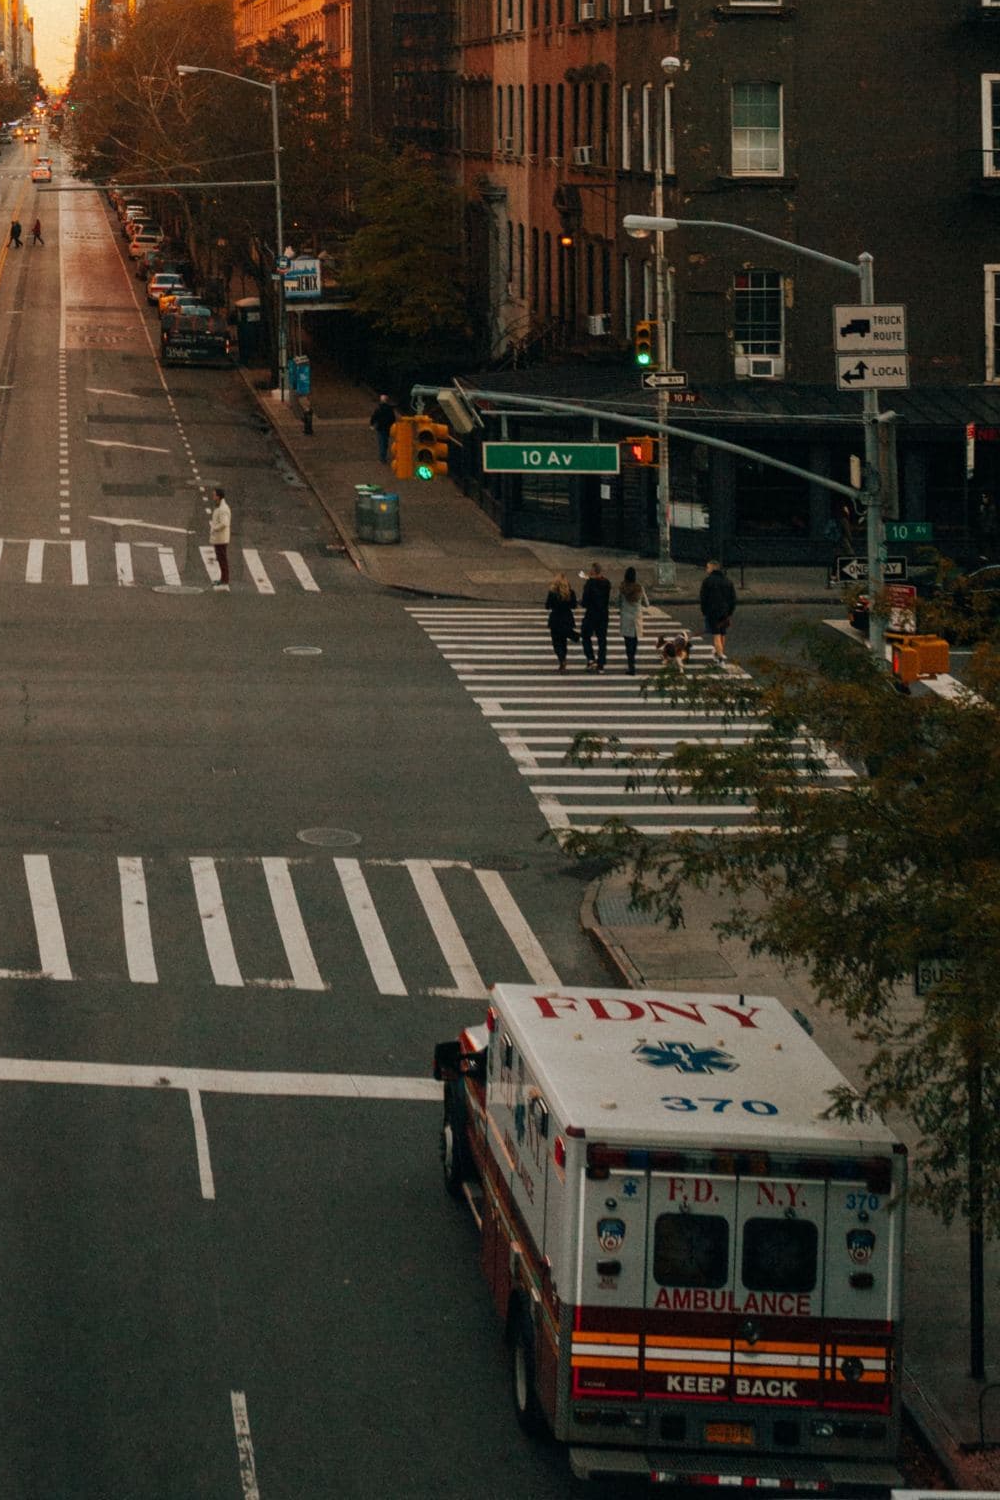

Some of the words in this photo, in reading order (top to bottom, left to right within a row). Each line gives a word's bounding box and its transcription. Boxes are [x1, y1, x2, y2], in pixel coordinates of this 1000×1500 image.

[873, 315, 902, 325] TRUCK
[873, 331, 902, 341] ROUTE
[872, 366, 905, 376] LOCAL
[674, 394, 683, 402] 10
[522, 451, 542, 465] 10
[547, 451, 573, 466] Av
[892, 525, 908, 539] 10
[849, 565, 869, 574] ONE
[532, 996, 761, 1029] FDNY
[660, 1096, 778, 1116] 370
[845, 1193, 880, 1211] 370
[654, 1287, 812, 1316] AMBULANCE
[666, 1375, 726, 1393] KEEP
[736, 1378, 799, 1398] BACK
